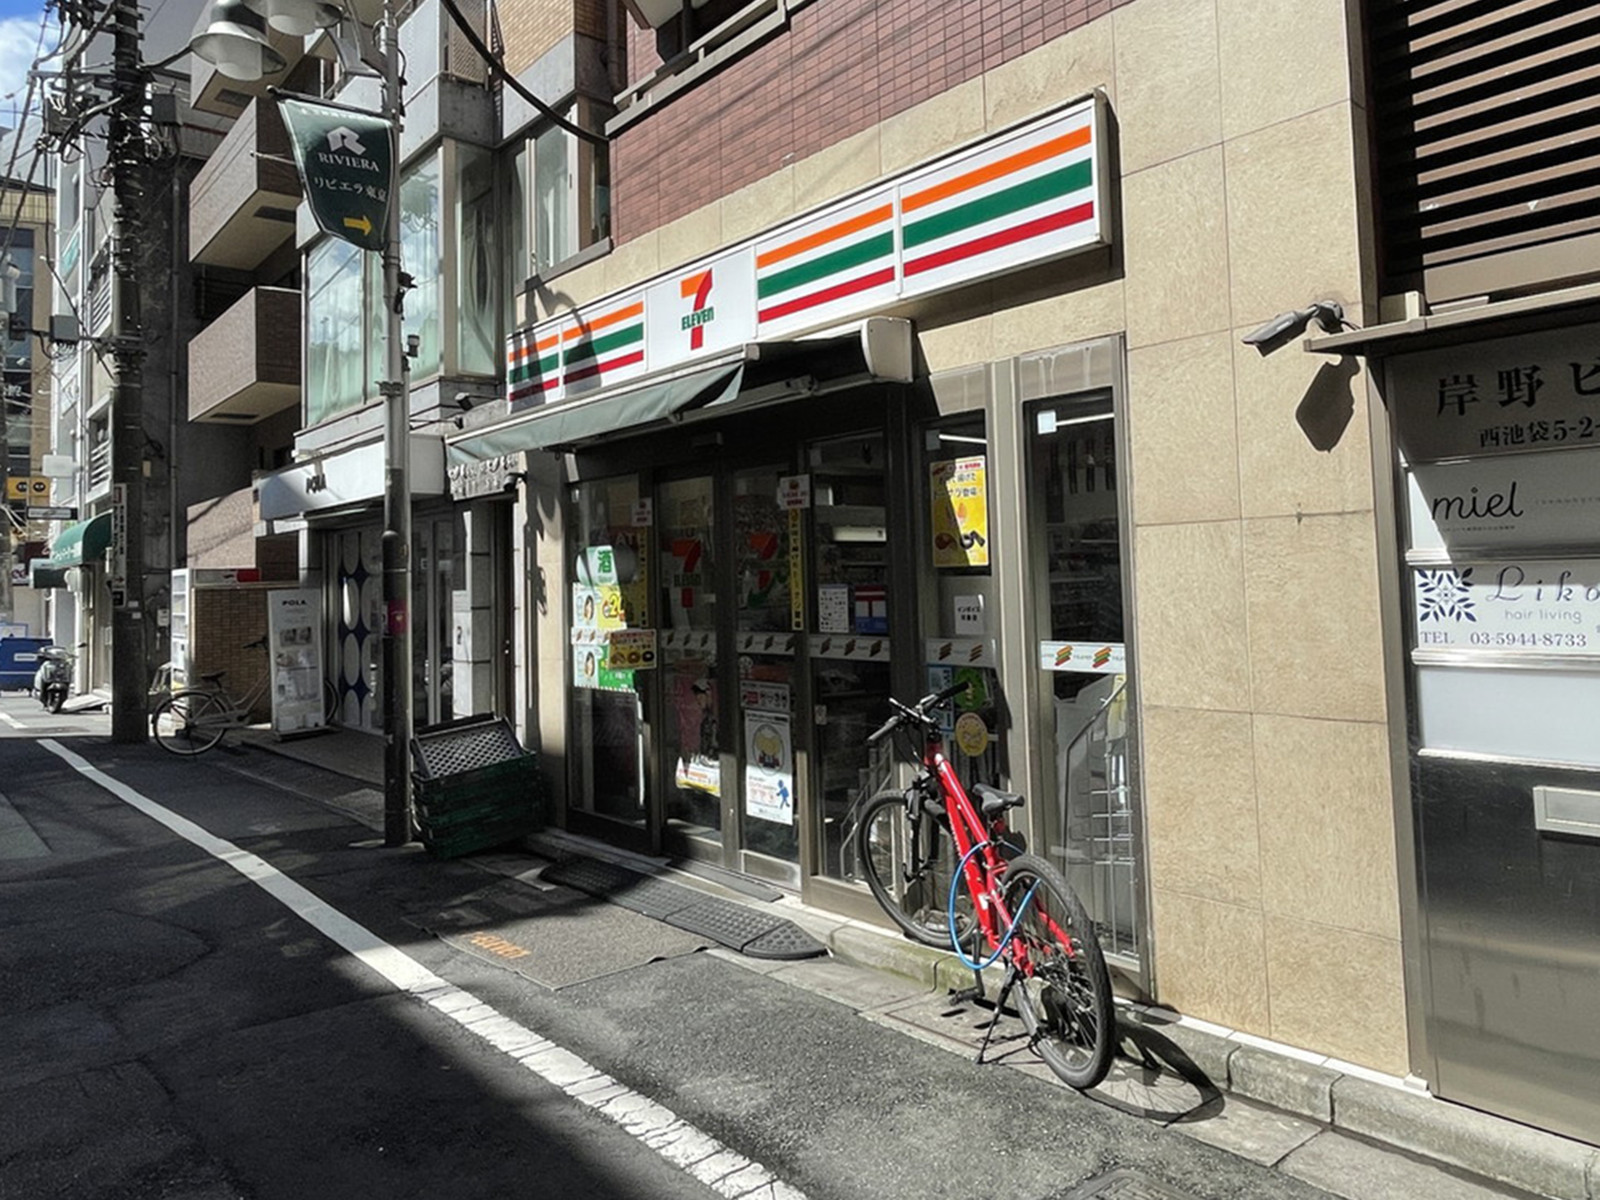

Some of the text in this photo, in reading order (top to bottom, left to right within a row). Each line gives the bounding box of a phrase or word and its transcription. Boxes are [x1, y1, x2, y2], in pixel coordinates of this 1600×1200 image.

[318, 152, 380, 172] RIVIERA
[314, 177, 387, 202] リビエラ東京
[681, 267, 713, 351] 7
[1431, 481, 1524, 520] miel
[597, 550, 612, 573] 酒
[281, 599, 307, 607] POLA
[1505, 609, 1582, 624] hair living
[1420, 632, 1587, 648] TEL 03-5944-8733
